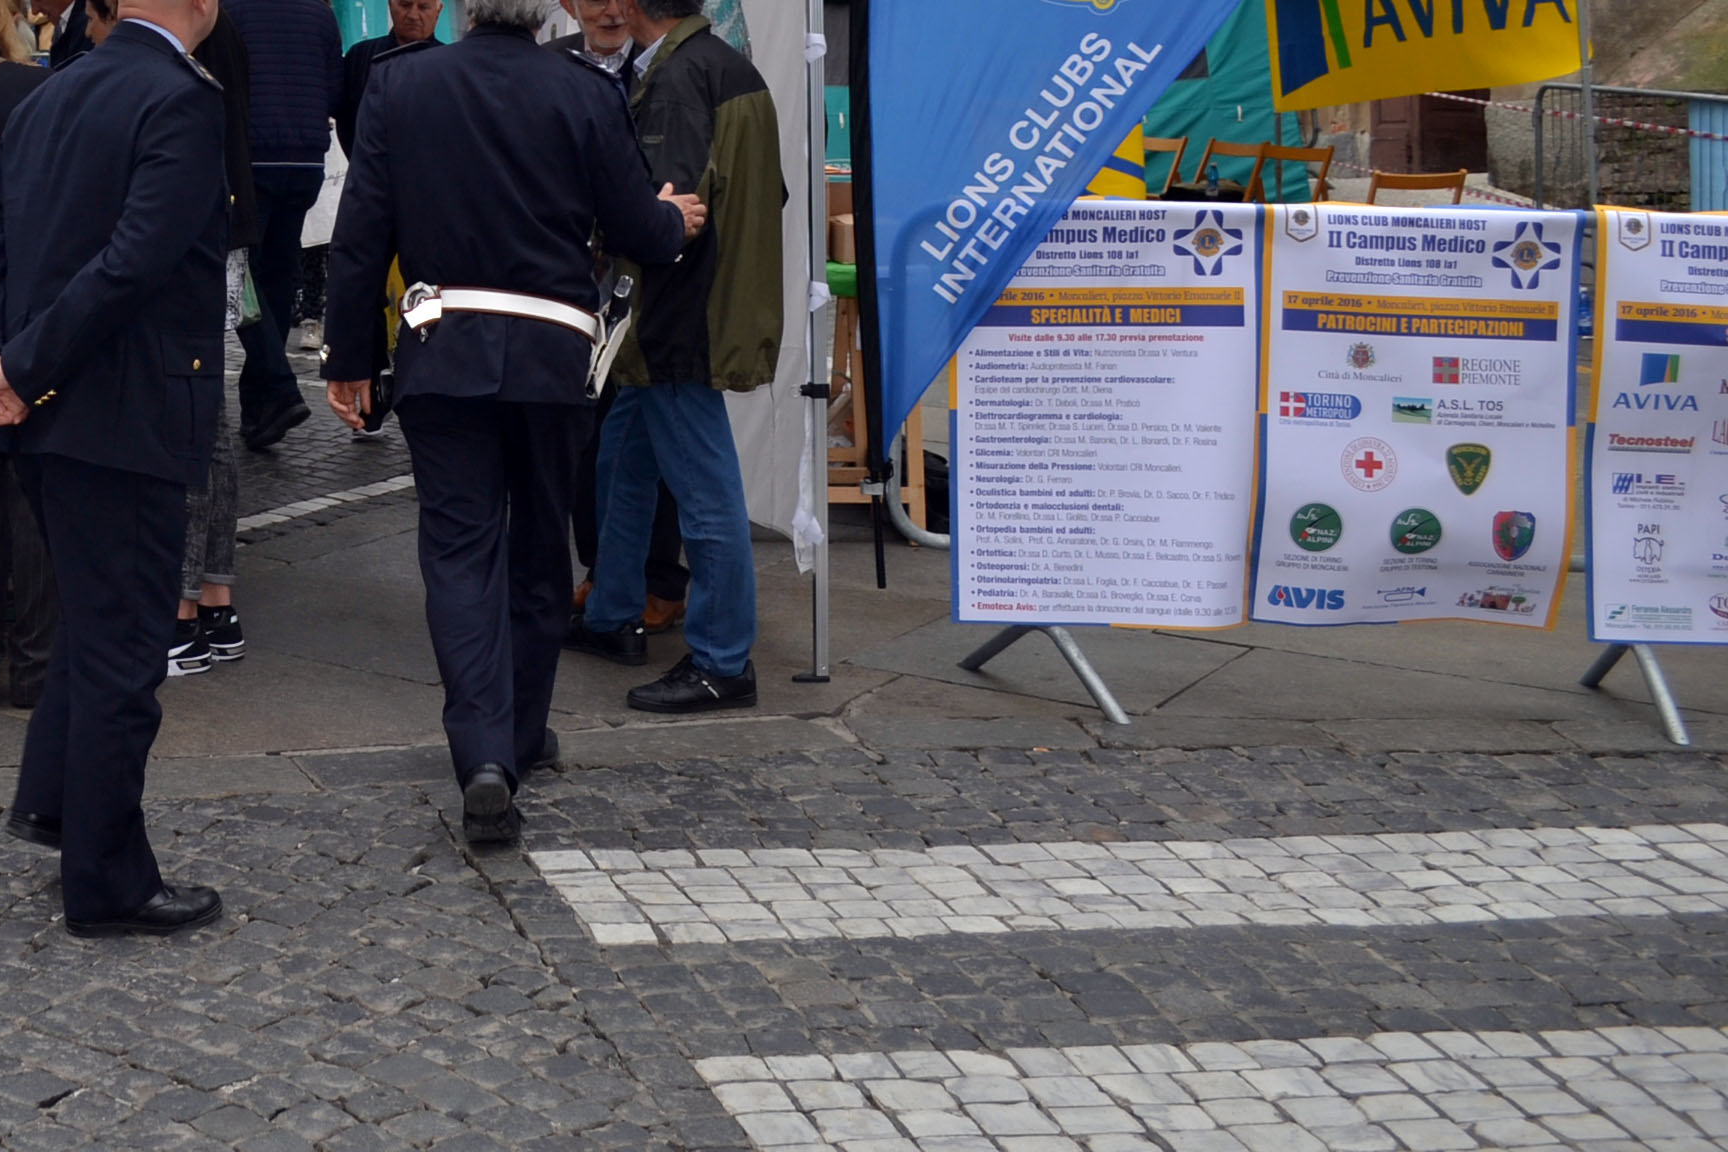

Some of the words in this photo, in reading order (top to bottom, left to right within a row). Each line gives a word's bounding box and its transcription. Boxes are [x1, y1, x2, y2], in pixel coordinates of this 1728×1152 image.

[920, 152, 1015, 261] LIONS
[1009, 33, 1112, 150] CLUBS
[932, 42, 1163, 304] INTERNATIONAL
[1071, 209, 1136, 221] MONCALIERI
[1139, 209, 1167, 221] HOST
[1328, 214, 1359, 225] LIONS
[1361, 215, 1388, 226] CLUB
[1391, 216, 1456, 230] MONCALIERI
[1458, 219, 1488, 231] HOST
[1102, 227, 1165, 243] Medico
[1660, 223, 1691, 236] LIONS
[1694, 225, 1721, 237] CLUB
[1328, 231, 1342, 248] II
[1346, 232, 1416, 253] Campus
[1422, 235, 1486, 254] Medico
[1036, 250, 1076, 260] Distretto
[1080, 250, 1104, 260] Lions
[1108, 250, 1122, 260] 108
[1660, 240, 1674, 258] II
[1355, 256, 1395, 268] Distretto
[1398, 257, 1422, 268] Lions
[1426, 258, 1441, 269] 108
[1015, 265, 1072, 277] revenzione
[1073, 265, 1121, 277] Sanitaria
[1123, 265, 1165, 277] Gratuita
[1326, 270, 1392, 284] Prevenzione
[1393, 272, 1438, 286] Sanitaria
[1440, 274, 1482, 288] Gratuita
[1660, 280, 1725, 295] Prevenzione
[1019, 292, 1044, 301] 2016
[1288, 295, 1300, 304] 17
[1302, 296, 1334, 307] aprile
[1337, 297, 1362, 308] 2016
[1031, 307, 1111, 323] SPECIALITÀ
[1115, 309, 1123, 323] E
[1130, 309, 1181, 323] MEDICI
[1622, 305, 1633, 314] 17
[1636, 307, 1669, 318] aprile
[1672, 308, 1697, 318] 2016
[1318, 314, 1397, 332] PATROCINI
[1400, 317, 1408, 332] E
[1412, 318, 1524, 336] PARTECIPAZIONI
[1009, 334, 1032, 342] Visite
[1034, 334, 1054, 342] dalle
[1057, 334, 1075, 342] 9.30
[1077, 333, 1093, 342] alle
[1095, 333, 1117, 341] 17.30
[1119, 334, 1146, 342] previa
[1149, 334, 1204, 343] prenotazione
[975, 349, 1034, 357] Alimentazione
[1044, 349, 1060, 357] Stili
[1063, 349, 1070, 357] di
[1073, 349, 1093, 357] Vita:
[975, 362, 1029, 370] Audiometria:
[1462, 358, 1521, 373] REGIONE
[975, 376, 1023, 384] Cardioteam
[1052, 377, 1102, 385] prevenzione
[1104, 376, 1175, 384] cardiovascolare:
[1318, 370, 1339, 379] Città
[1341, 371, 1350, 380] di
[1352, 372, 1402, 383] Moncalieri
[1462, 373, 1520, 386] PIEMONTE
[975, 399, 1033, 408] Dermatologia:
[1306, 393, 1352, 408] TORINO
[1437, 400, 1474, 411] A.S.L.
[1477, 400, 1503, 411] TO5
[1612, 392, 1699, 411] AVIVA
[975, 413, 1063, 421] Elettrocardiogramma
[1073, 412, 1123, 421] cardiologia:
[1306, 406, 1352, 419] METROPOLI
[975, 436, 1052, 444] Gastroenterologia:
[1609, 434, 1695, 448] Tecnosteel
[975, 449, 1014, 457] Glicemia:
[976, 462, 1030, 470] Misurazione
[1032, 462, 1049, 470] della
[1051, 463, 1096, 471] Pressione:
[976, 475, 1023, 484] Neurologia:
[976, 488, 1017, 497] Oculistica
[1019, 489, 1054, 497] bambini
[1056, 489, 1066, 497] ed
[976, 502, 1021, 510] Ortodonzia
[1092, 503, 1124, 511] dentali:
[976, 526, 1017, 535] Ortopedia
[1019, 526, 1053, 534] bambini
[1056, 526, 1066, 534] ed
[1637, 524, 1660, 534] PAPI
[977, 549, 1016, 557] Ortottica:
[977, 562, 1030, 571] Osteoporosi:
[977, 589, 1018, 597] Pediatria:
[1268, 584, 1345, 610] AVIS
[977, 602, 1013, 610] Emoteca
[1016, 603, 1037, 611] Avis:
